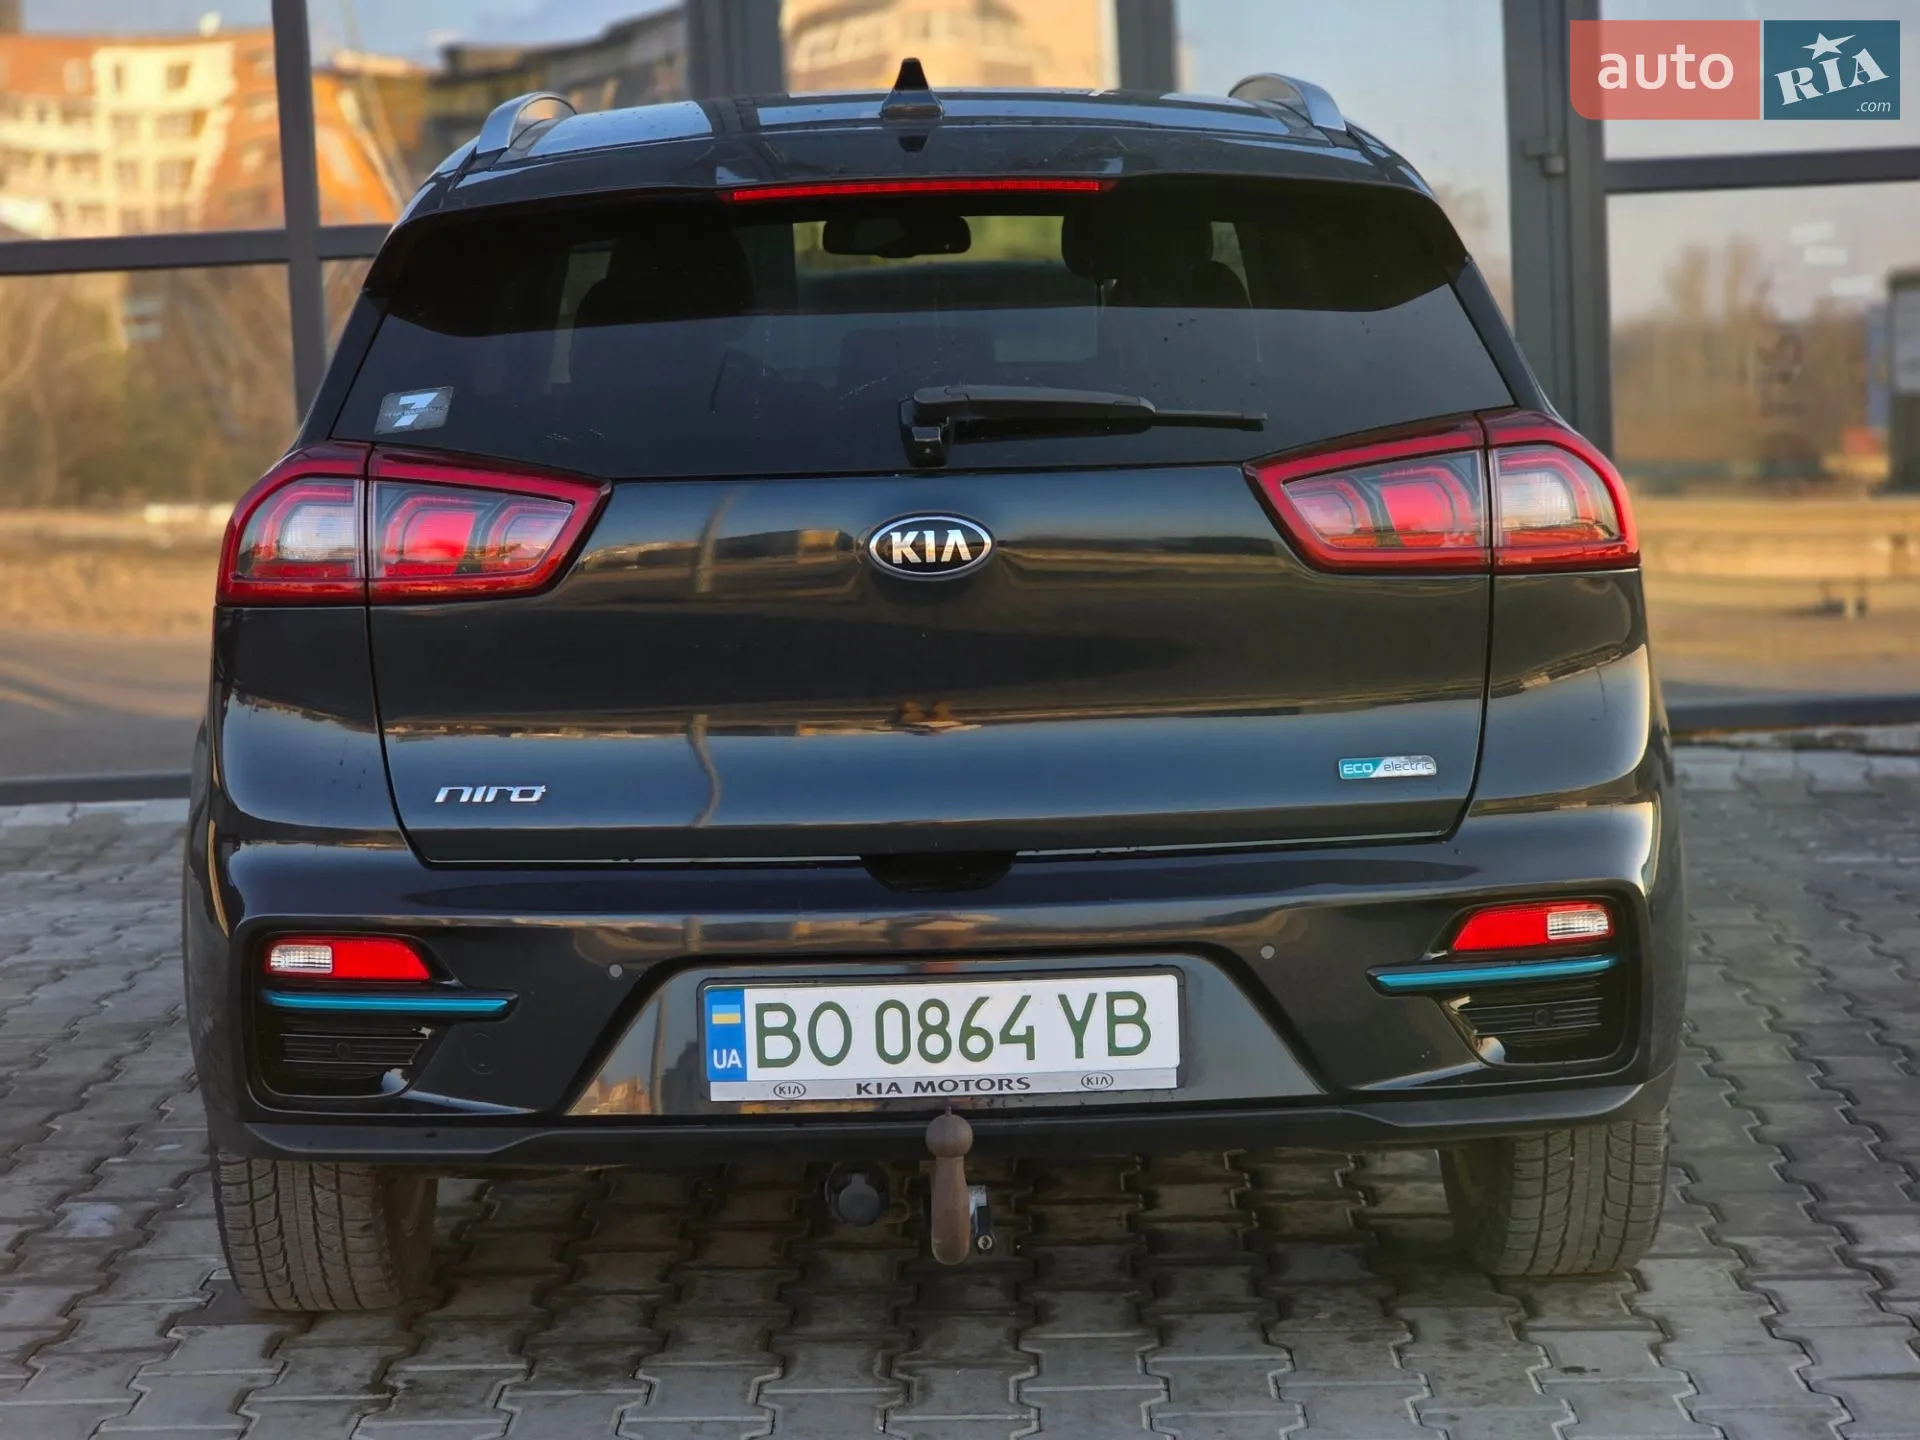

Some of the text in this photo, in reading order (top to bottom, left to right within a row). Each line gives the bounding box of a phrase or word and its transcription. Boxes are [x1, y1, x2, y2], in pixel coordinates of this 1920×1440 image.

[890, 529, 972, 564] KIA
[1343, 761, 1433, 774] ECO electric
[755, 990, 1152, 1068] BO 0864 YB
[713, 1049, 742, 1069] UA
[779, 1084, 803, 1096] KIA
[855, 1075, 1031, 1096] KIA MOTORS
[1085, 1075, 1110, 1086] KIA
